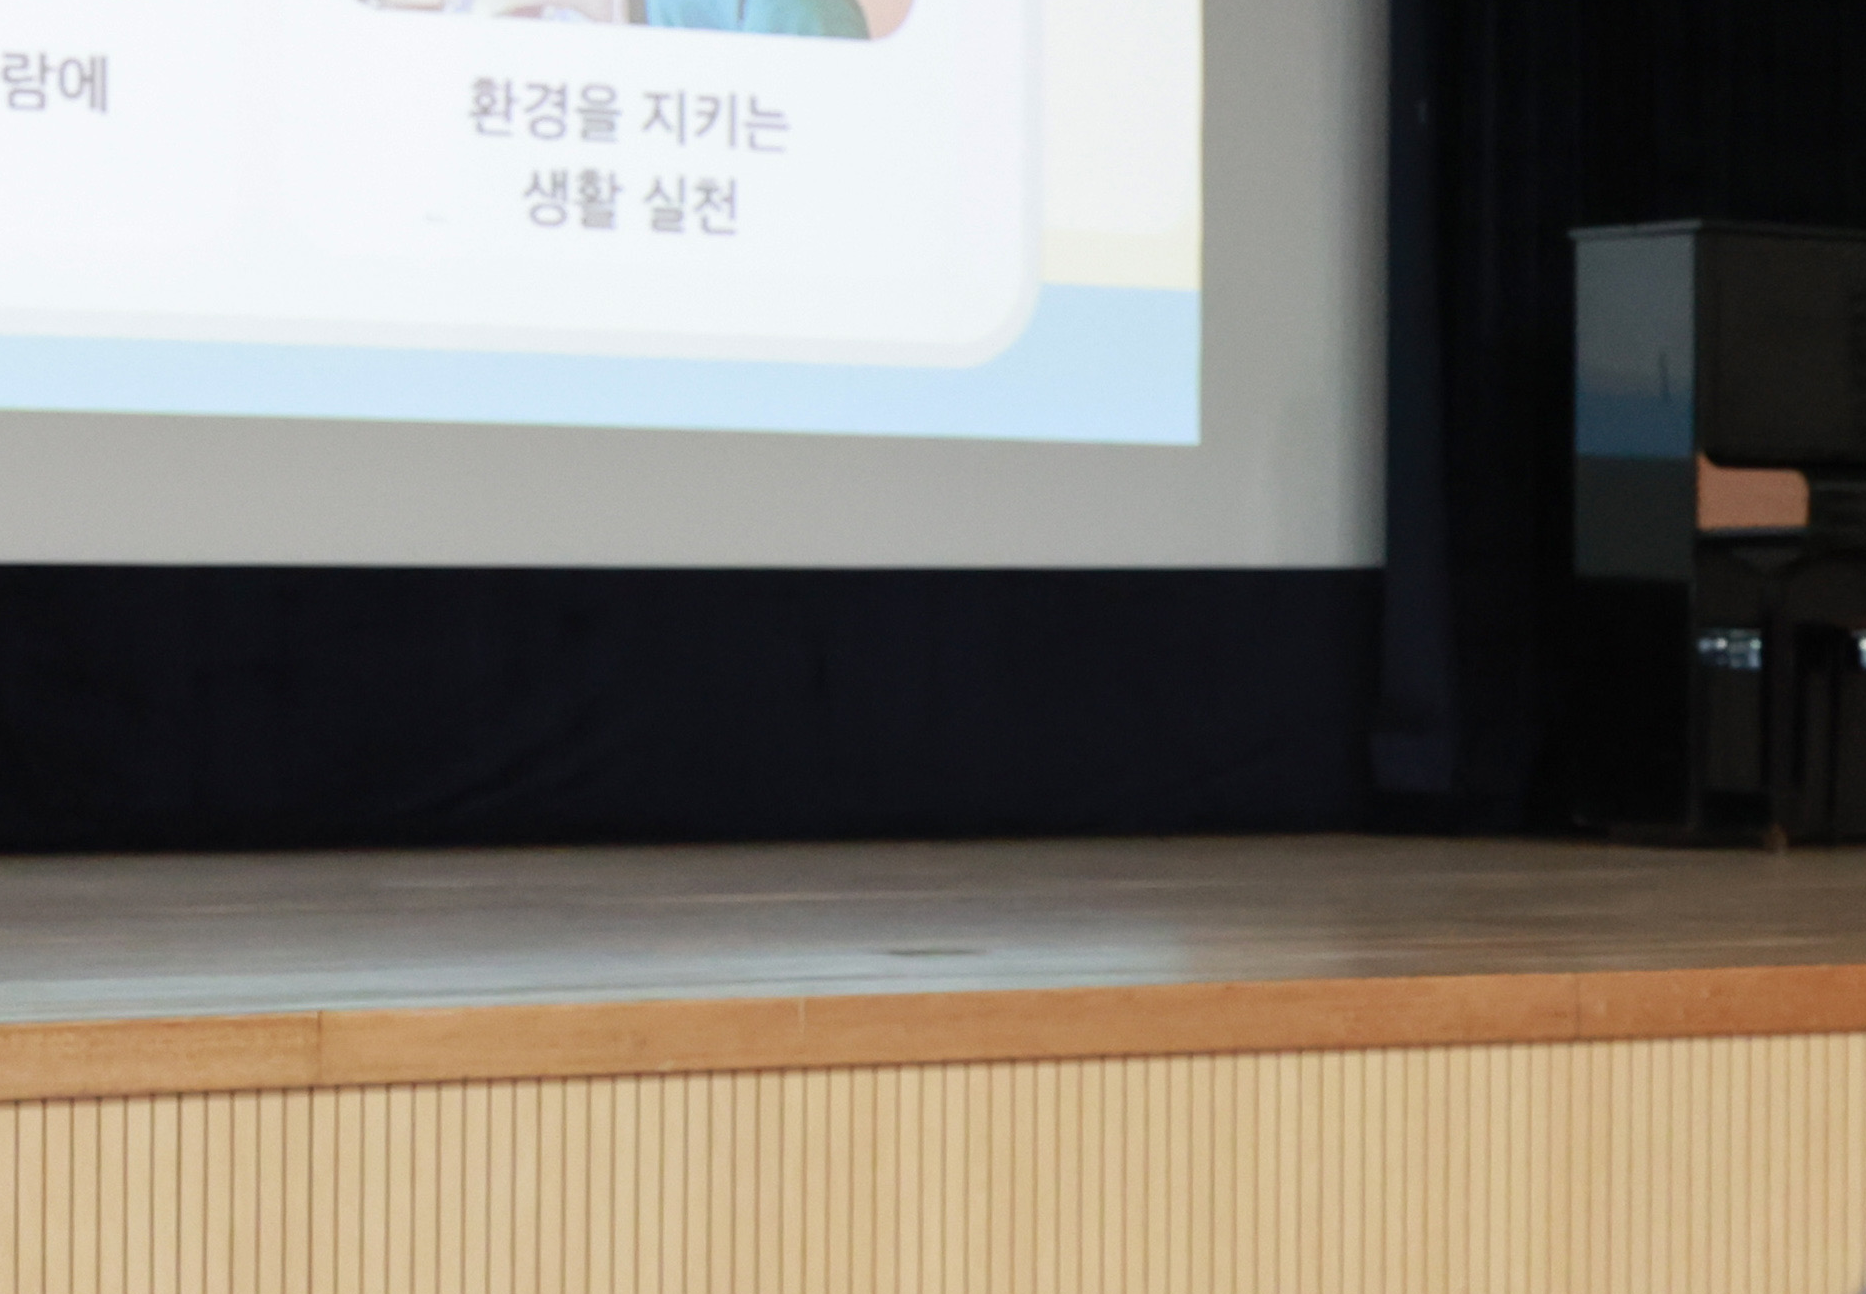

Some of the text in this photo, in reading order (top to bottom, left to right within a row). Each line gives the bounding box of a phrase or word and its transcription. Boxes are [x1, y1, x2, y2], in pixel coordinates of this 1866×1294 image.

[469, 77, 788, 152] 환경을 지키는
[524, 168, 738, 235] 생활 실천
